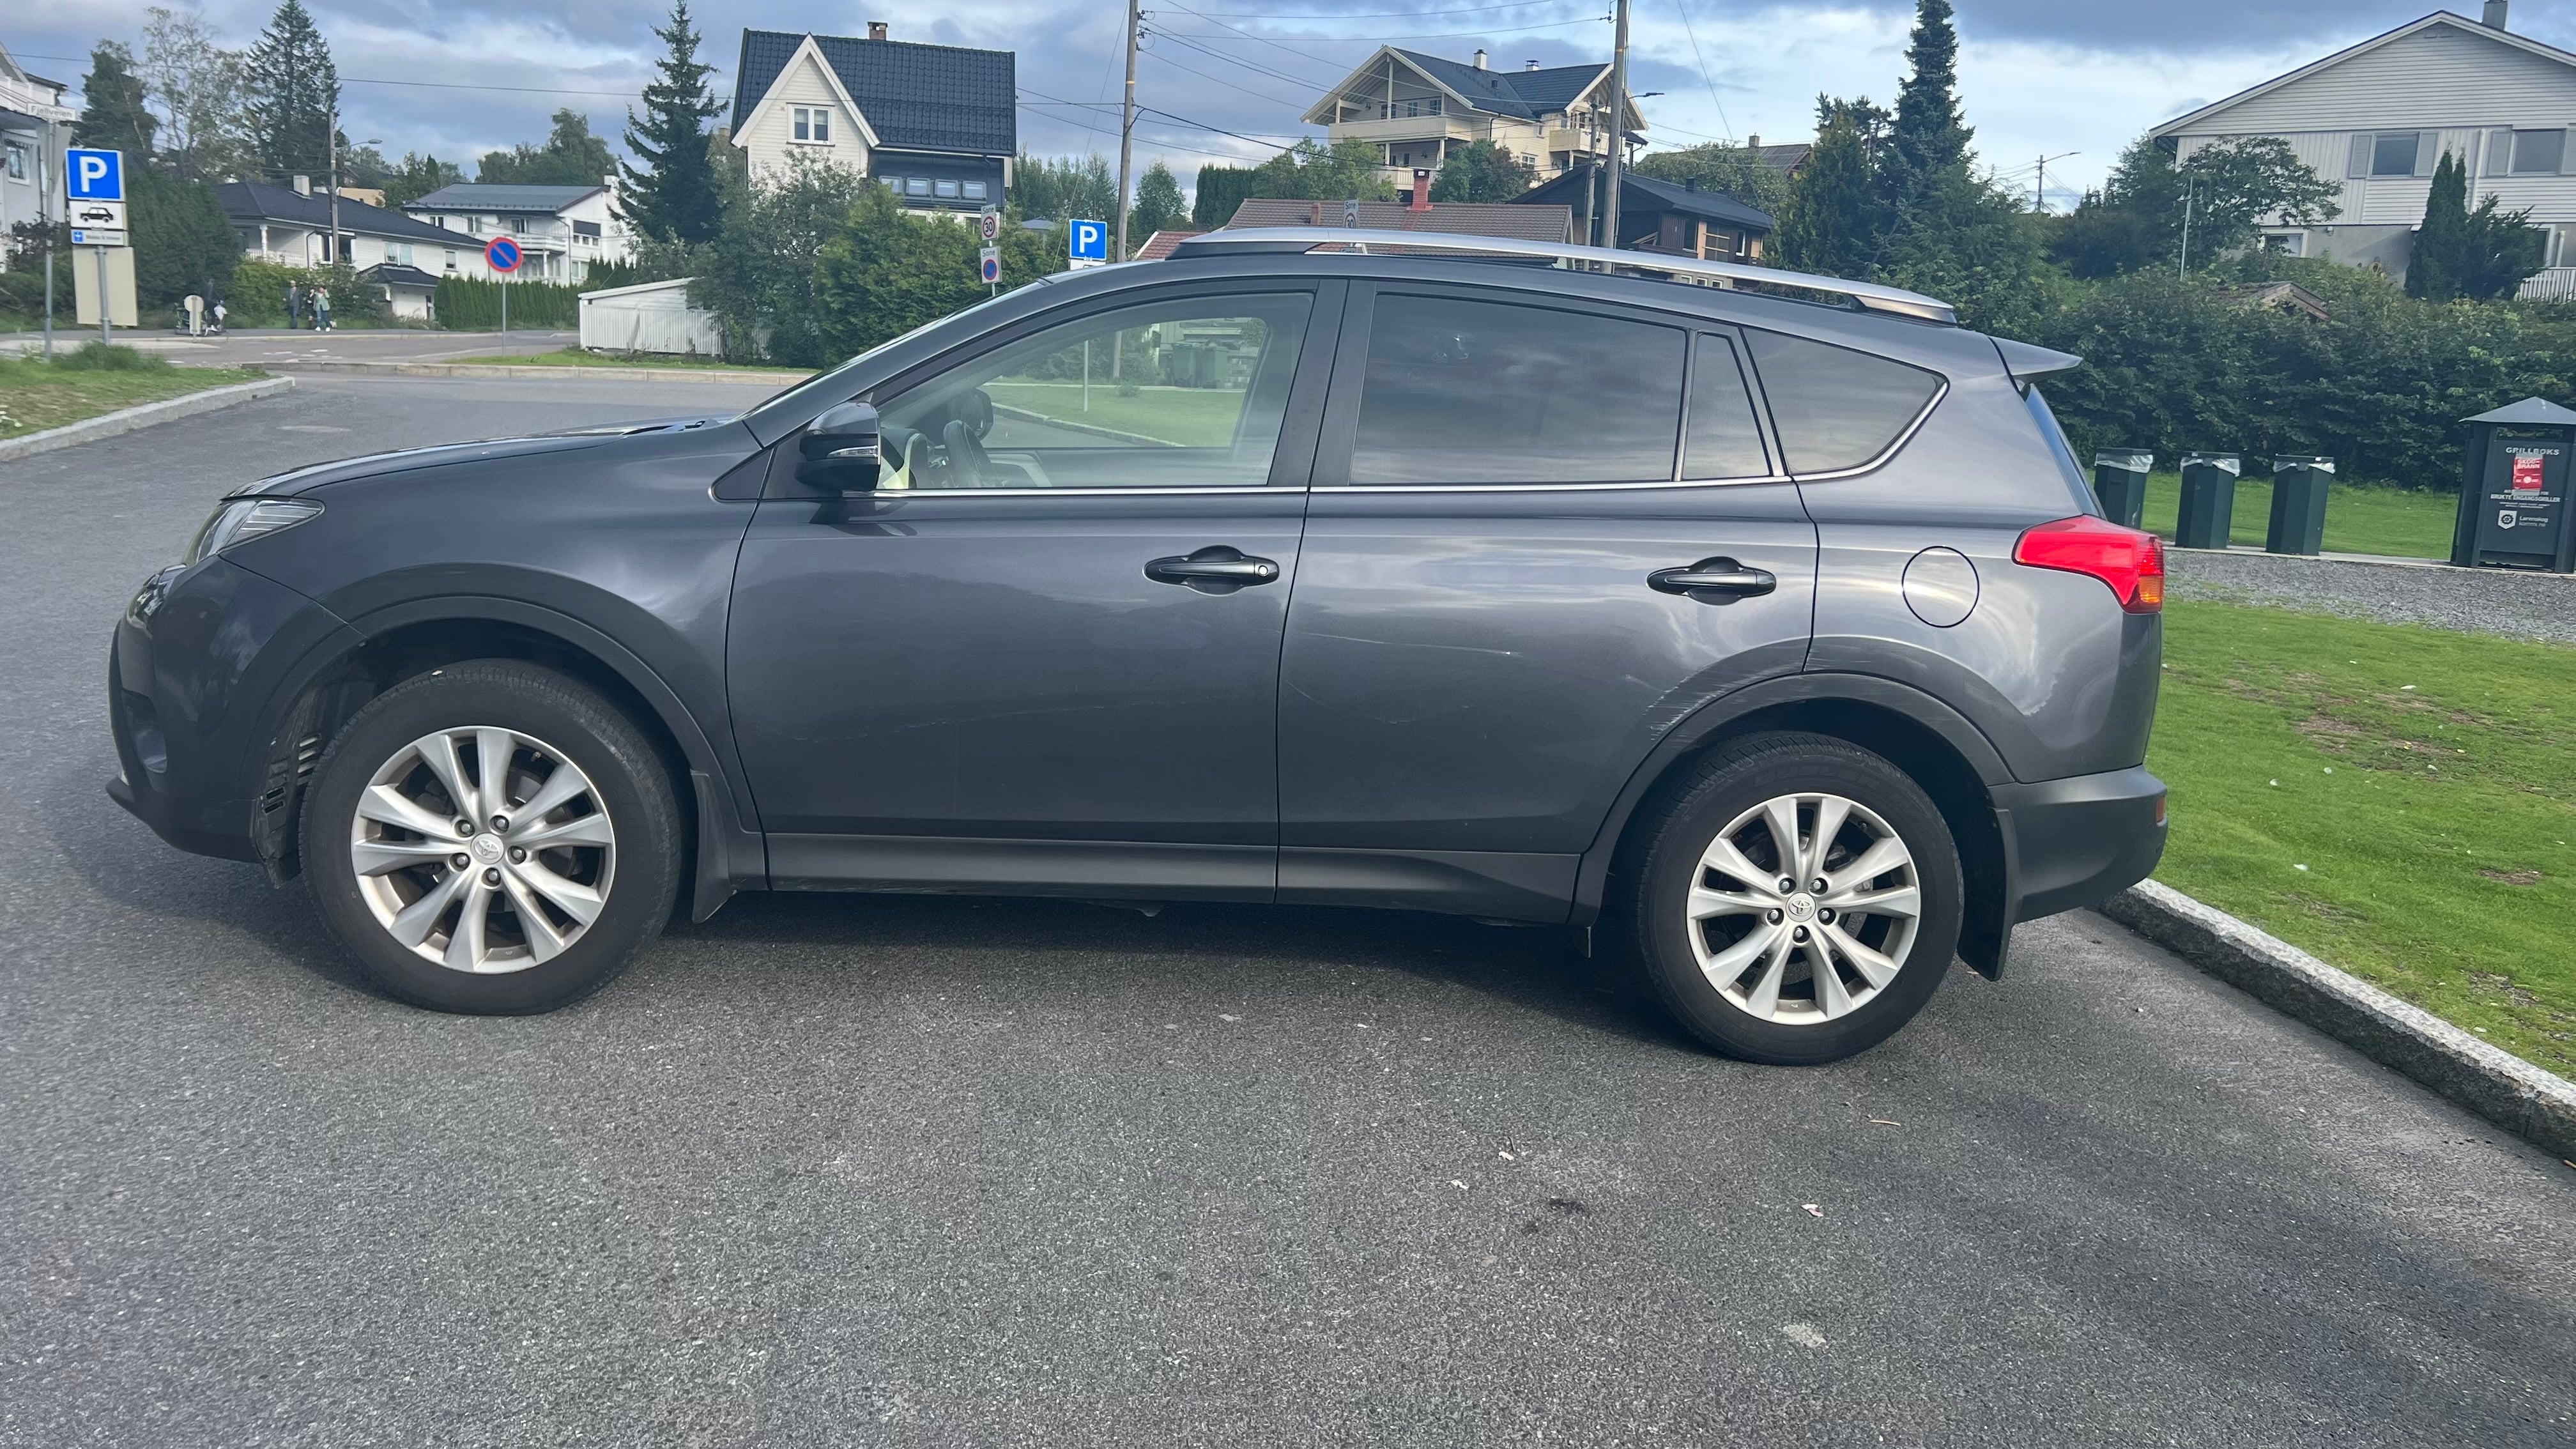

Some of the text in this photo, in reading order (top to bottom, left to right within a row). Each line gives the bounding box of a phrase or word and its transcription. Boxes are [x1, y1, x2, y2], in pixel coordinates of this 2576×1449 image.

[31, 105, 72, 117] Fjellveien
[79, 156, 107, 192] P
[985, 222, 993, 233] 30
[1080, 226, 1098, 253] P
[2505, 447, 2559, 456] GRILLBOKS
